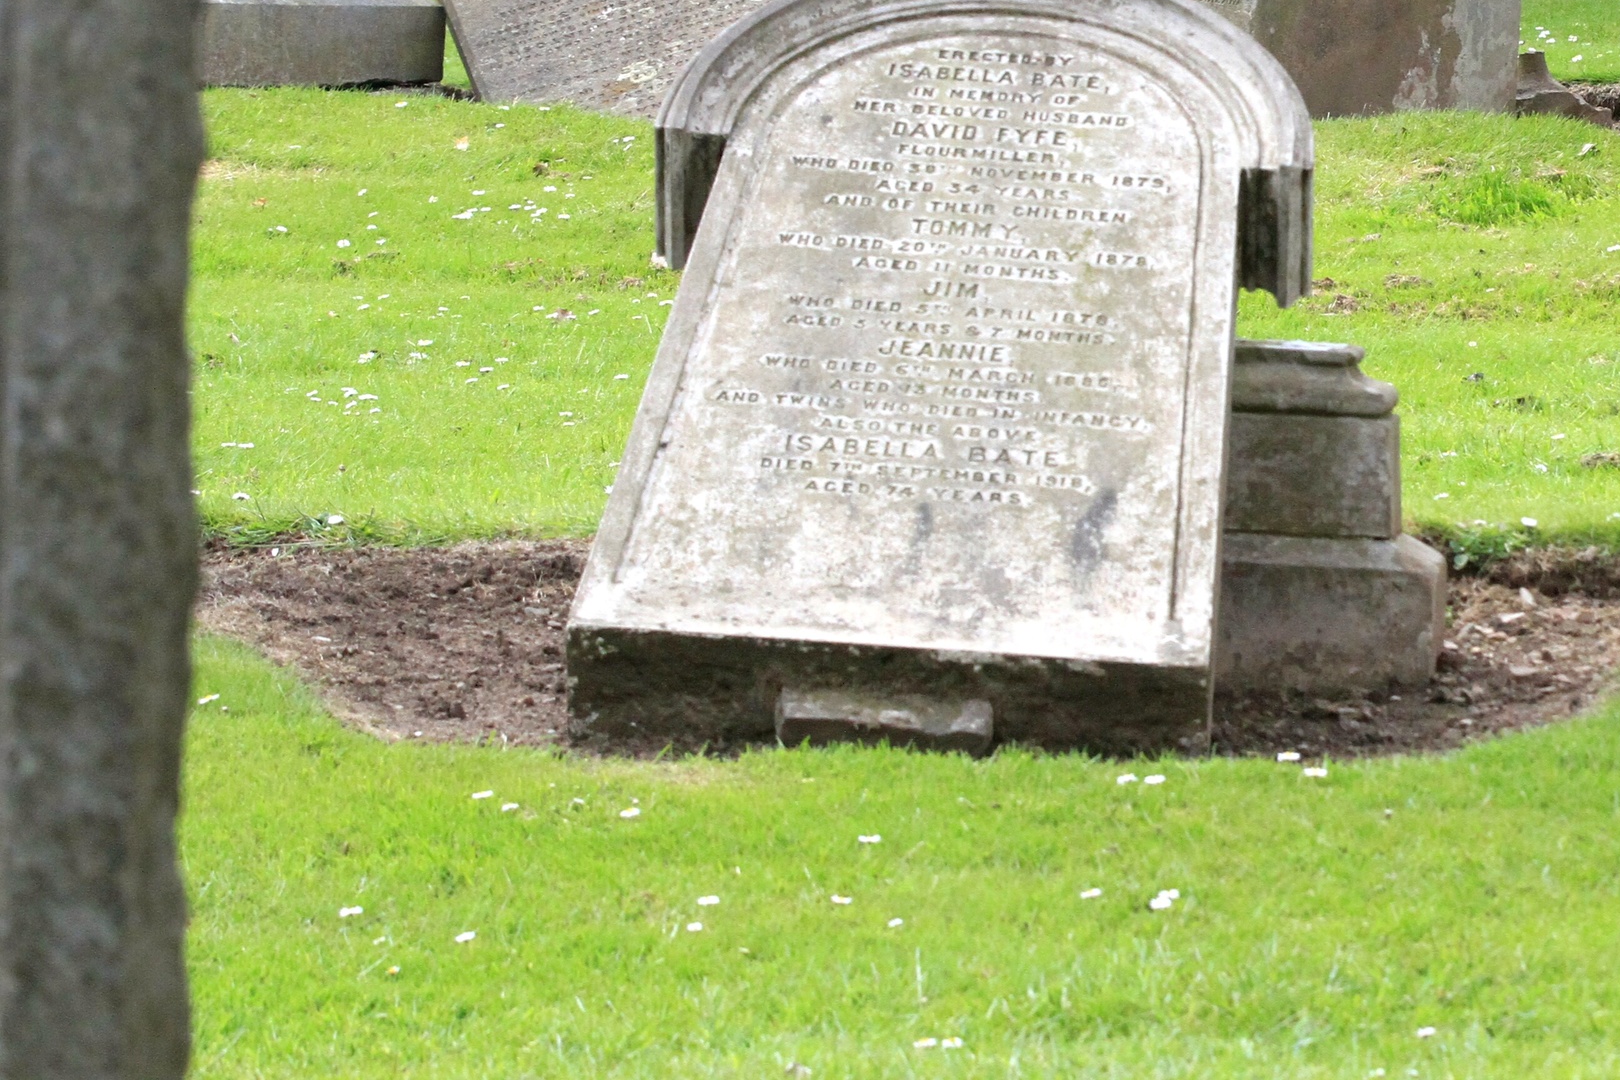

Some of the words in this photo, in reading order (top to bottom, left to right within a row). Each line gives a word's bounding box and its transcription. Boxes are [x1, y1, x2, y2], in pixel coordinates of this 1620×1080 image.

[939, 50, 1030, 64] ERECTED
[1045, 56, 1073, 66] BY
[889, 64, 1014, 84] ISABELLA
[914, 87, 934, 98] IN
[950, 90, 1041, 104] MEMORY
[1054, 94, 1081, 106] OF
[854, 100, 895, 113] HER
[912, 104, 1008, 119] BELOVED
[1023, 111, 1128, 127] HUSBAND
[891, 122, 977, 141] DAVID
[792, 156, 836, 169] WHO
[849, 161, 893, 173] DIED
[971, 167, 1095, 183] NOVEMBER
[877, 180, 934, 193] AGED
[948, 183, 980, 194] 34
[997, 186, 1070, 200] YEARS
[825, 195, 872, 207] AND
[888, 198, 913, 209] OF
[931, 201, 995, 214] THEIR
[1013, 206, 1128, 222] CHILDREN
[779, 233, 823, 245] WHO
[836, 238, 883, 250] DIED
[960, 245, 1079, 262] JANUARY
[856, 256, 917, 271] AGED
[789, 296, 834, 308] WHO
[851, 299, 901, 312] DIED
[965, 306, 1036, 321] APRIL
[765, 355, 810, 368] WHO
[826, 361, 877, 372] DIED
[949, 367, 1035, 384] MARCH
[716, 390, 760, 403] AND
[775, 394, 845, 408] TWINS
[863, 399, 911, 412] WHO
[928, 403, 977, 416] DIED
[992, 407, 1015, 419] IN
[820, 418, 881, 431] ALSO
[898, 422, 938, 435] THE
[953, 426, 1038, 441] ABOVE
[784, 434, 939, 459] ISABELLA
[968, 446, 1061, 468] BATE
[760, 458, 814, 471] DIED
[877, 464, 1017, 484] SEPTEMBER
[804, 480, 870, 495] AGED
[886, 484, 915, 498] 74
[933, 487, 1021, 505] YEARS
